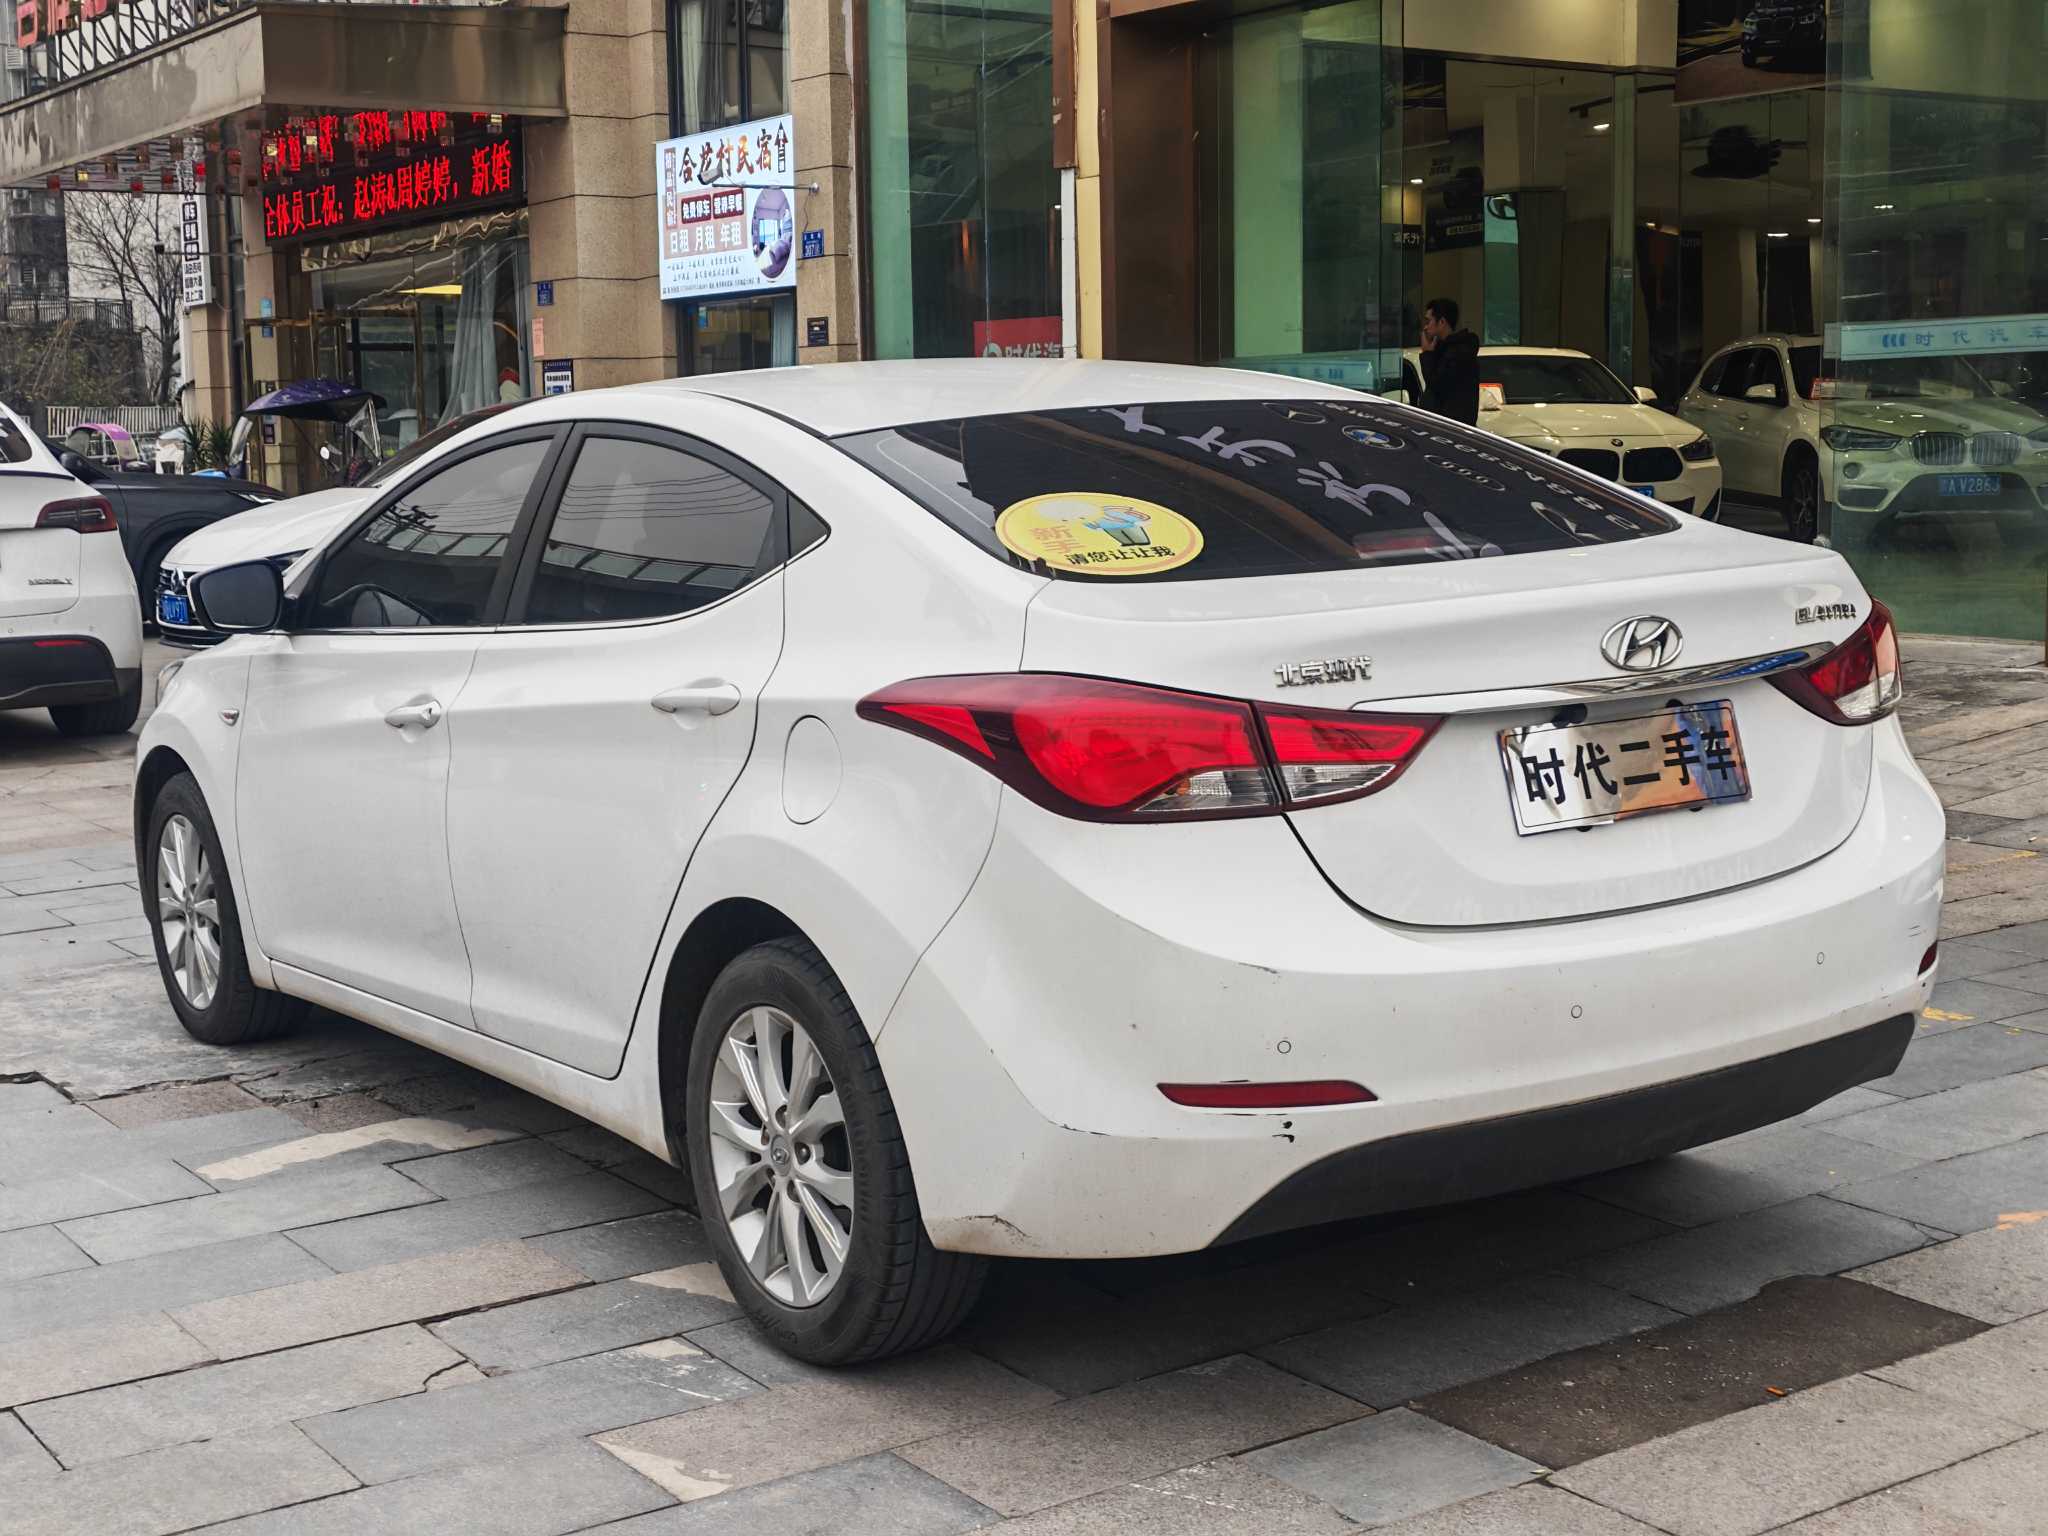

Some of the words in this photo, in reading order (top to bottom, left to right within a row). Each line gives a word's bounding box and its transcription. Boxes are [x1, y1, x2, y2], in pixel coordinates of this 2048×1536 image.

[695, 225, 715, 251] 月租
[720, 221, 742, 248] 年租
[1064, 545, 1175, 566] 请您让让我
[1274, 655, 1372, 688] 北京现代
[1520, 725, 1736, 804] 时代二手车
